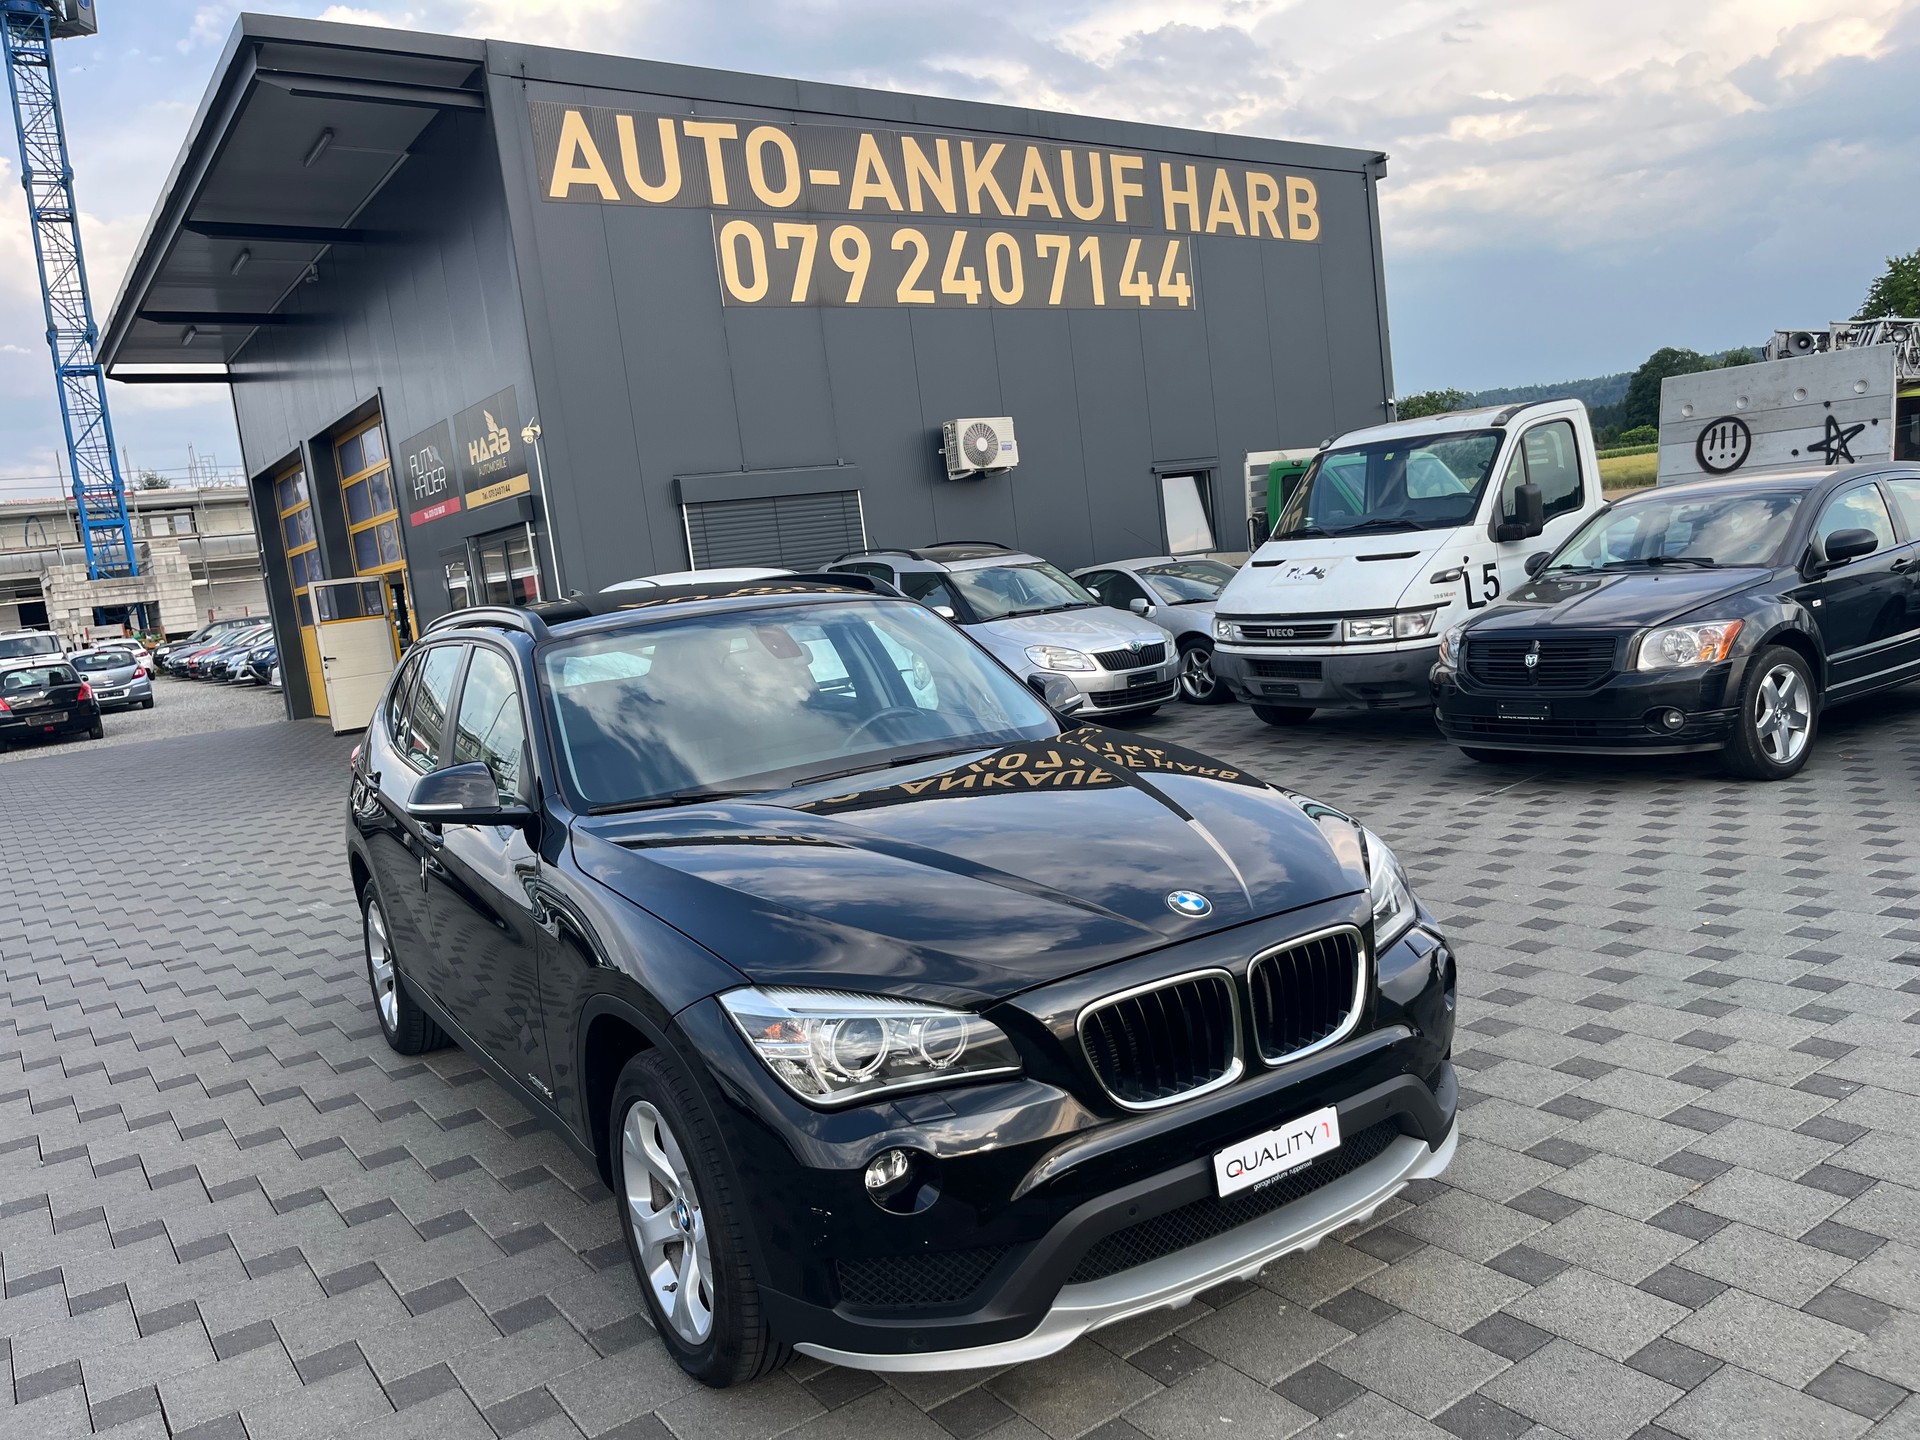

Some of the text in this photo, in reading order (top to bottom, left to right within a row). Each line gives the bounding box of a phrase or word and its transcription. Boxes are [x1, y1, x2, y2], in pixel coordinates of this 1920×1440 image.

[549, 110, 1320, 241] AUTO-ANKAUF HARB
[720, 220, 1191, 306] 079 240 71 44
[468, 427, 511, 465] HARB
[1266, 628, 1295, 637] IVECO
